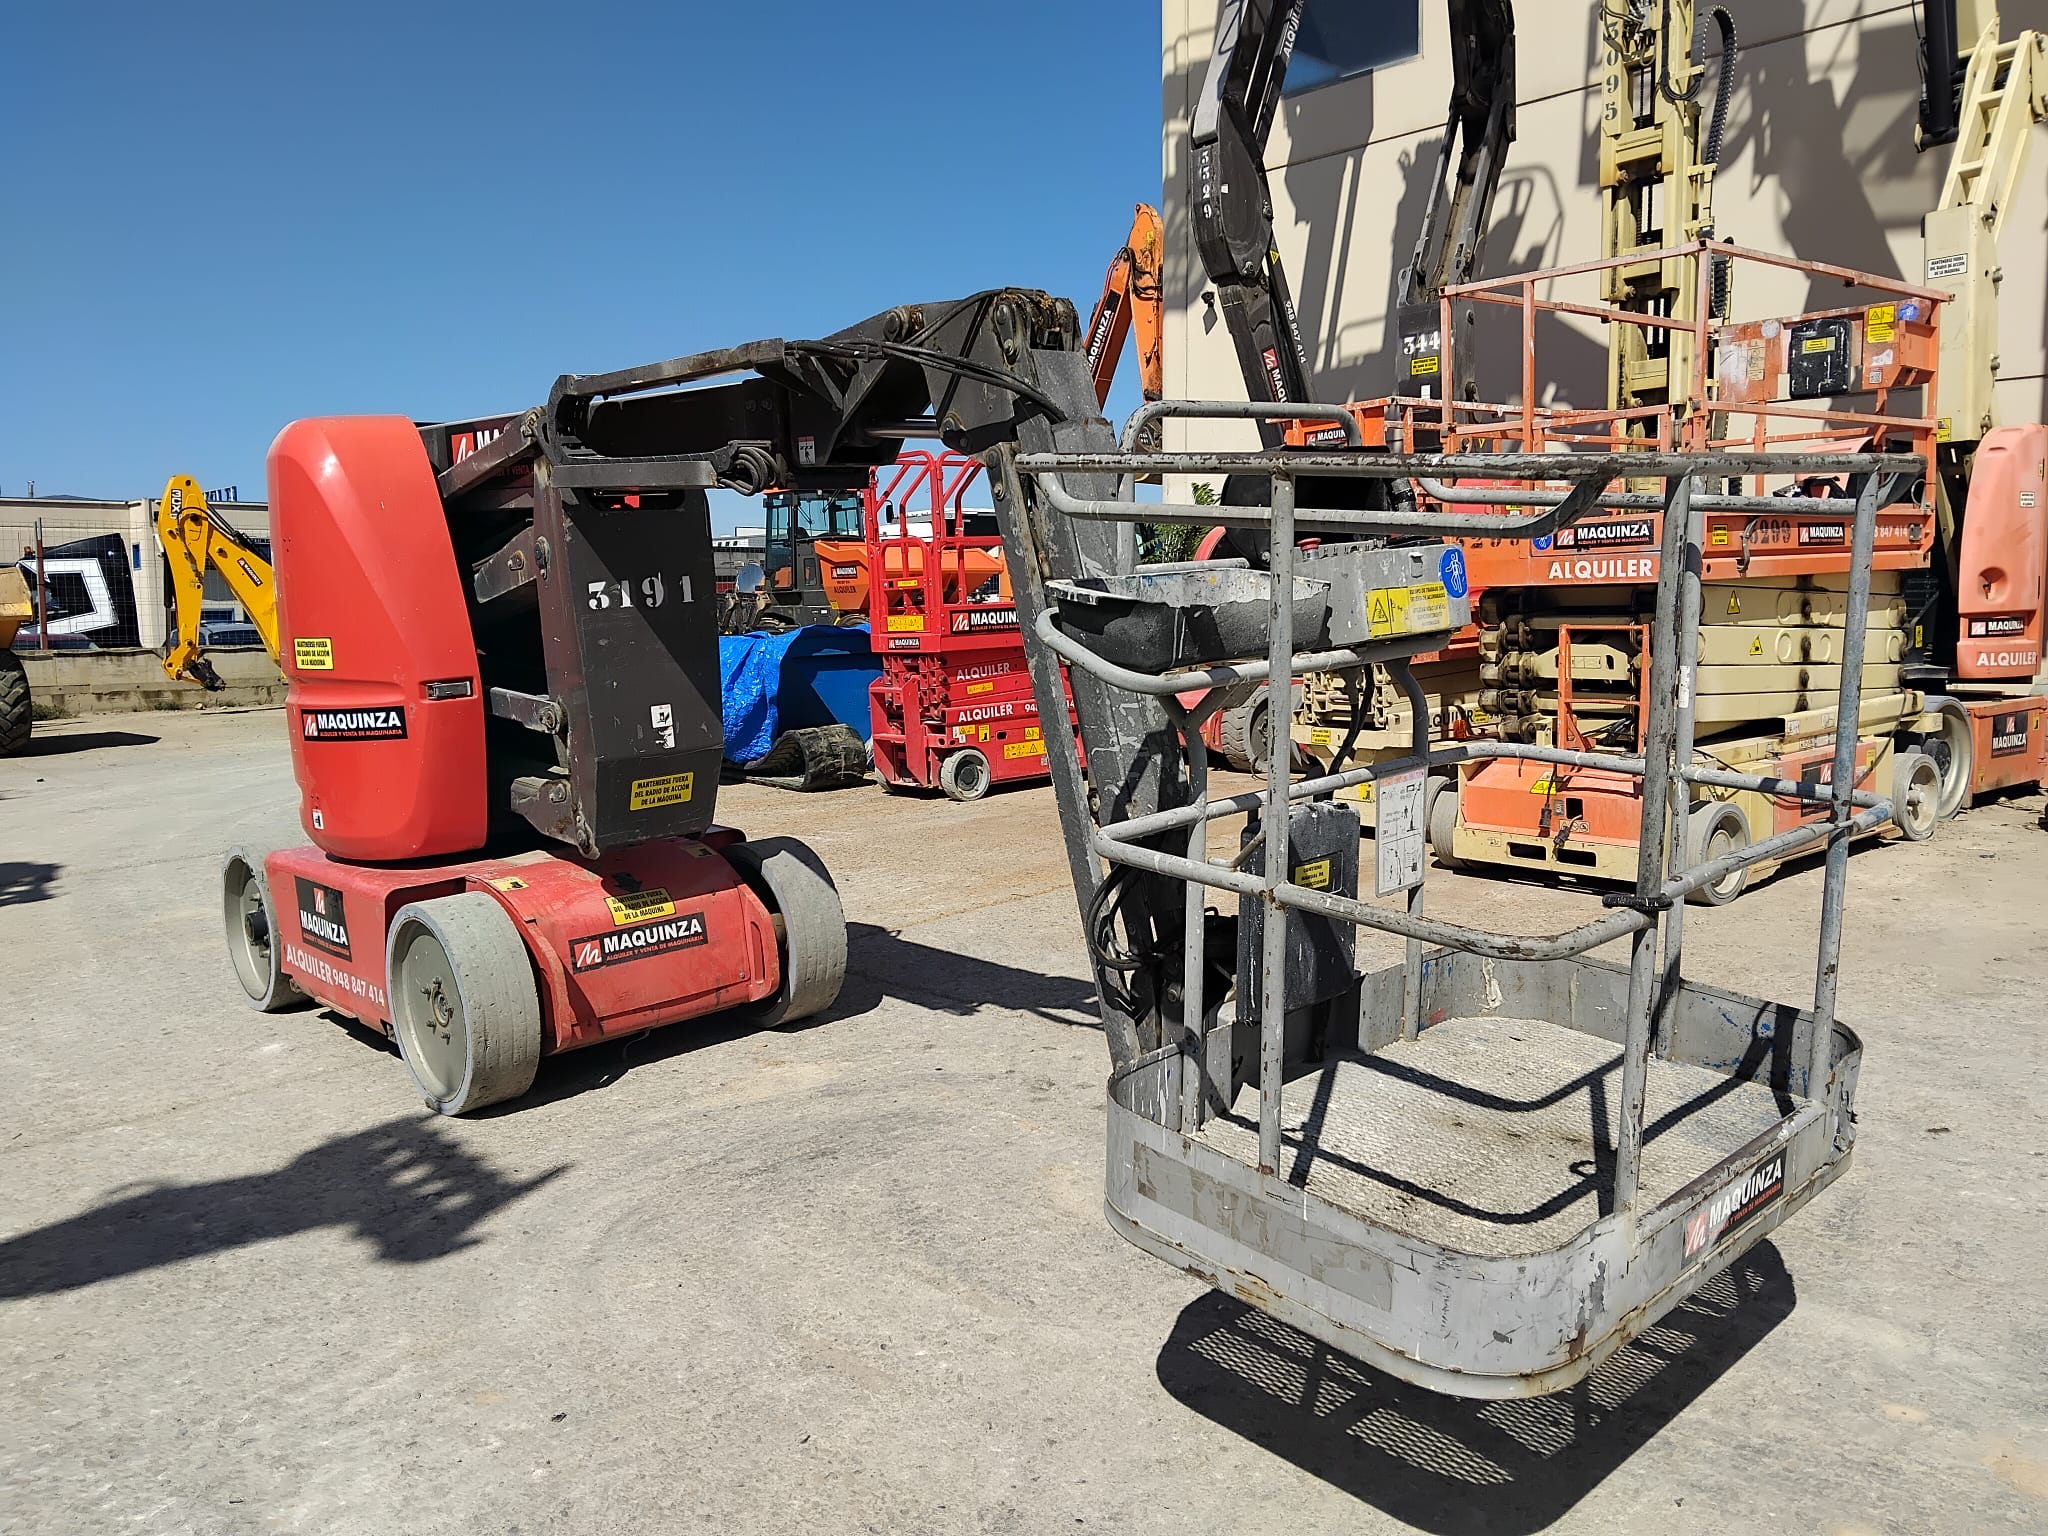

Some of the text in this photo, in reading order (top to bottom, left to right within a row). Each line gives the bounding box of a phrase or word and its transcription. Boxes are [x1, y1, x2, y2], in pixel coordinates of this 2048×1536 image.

[1285, 300, 1295, 320] 948
[1087, 309, 1112, 369] AQUINZA
[1403, 331, 1454, 355] 344
[1577, 525, 1650, 539] MAQUINZA
[1810, 527, 1843, 538] MAQUINZA
[1549, 559, 1653, 578] ALQUILER
[588, 573, 695, 610] 3191
[970, 611, 1019, 625] MAQUIN
[1976, 652, 2037, 666] ALQUILER
[957, 663, 1010, 681] ALQUILER
[317, 711, 401, 730] MAQUINZA
[958, 704, 1013, 722] ALQUILER
[1992, 734, 2026, 749] MAQUINZA
[637, 775, 688, 789] MANTENERSE FUERA
[645, 788, 661, 796] RADIO
[612, 893, 646, 904] MANTENERSE
[300, 909, 348, 945] MAQUINZA
[603, 919, 702, 954] MAQUINZA
[286, 943, 333, 986] ALQUILER
[333, 968, 350, 991] 948
[351, 976, 367, 998] 847
[369, 984, 385, 1007] 414
[1709, 1158, 1782, 1229] MAQUINZA
